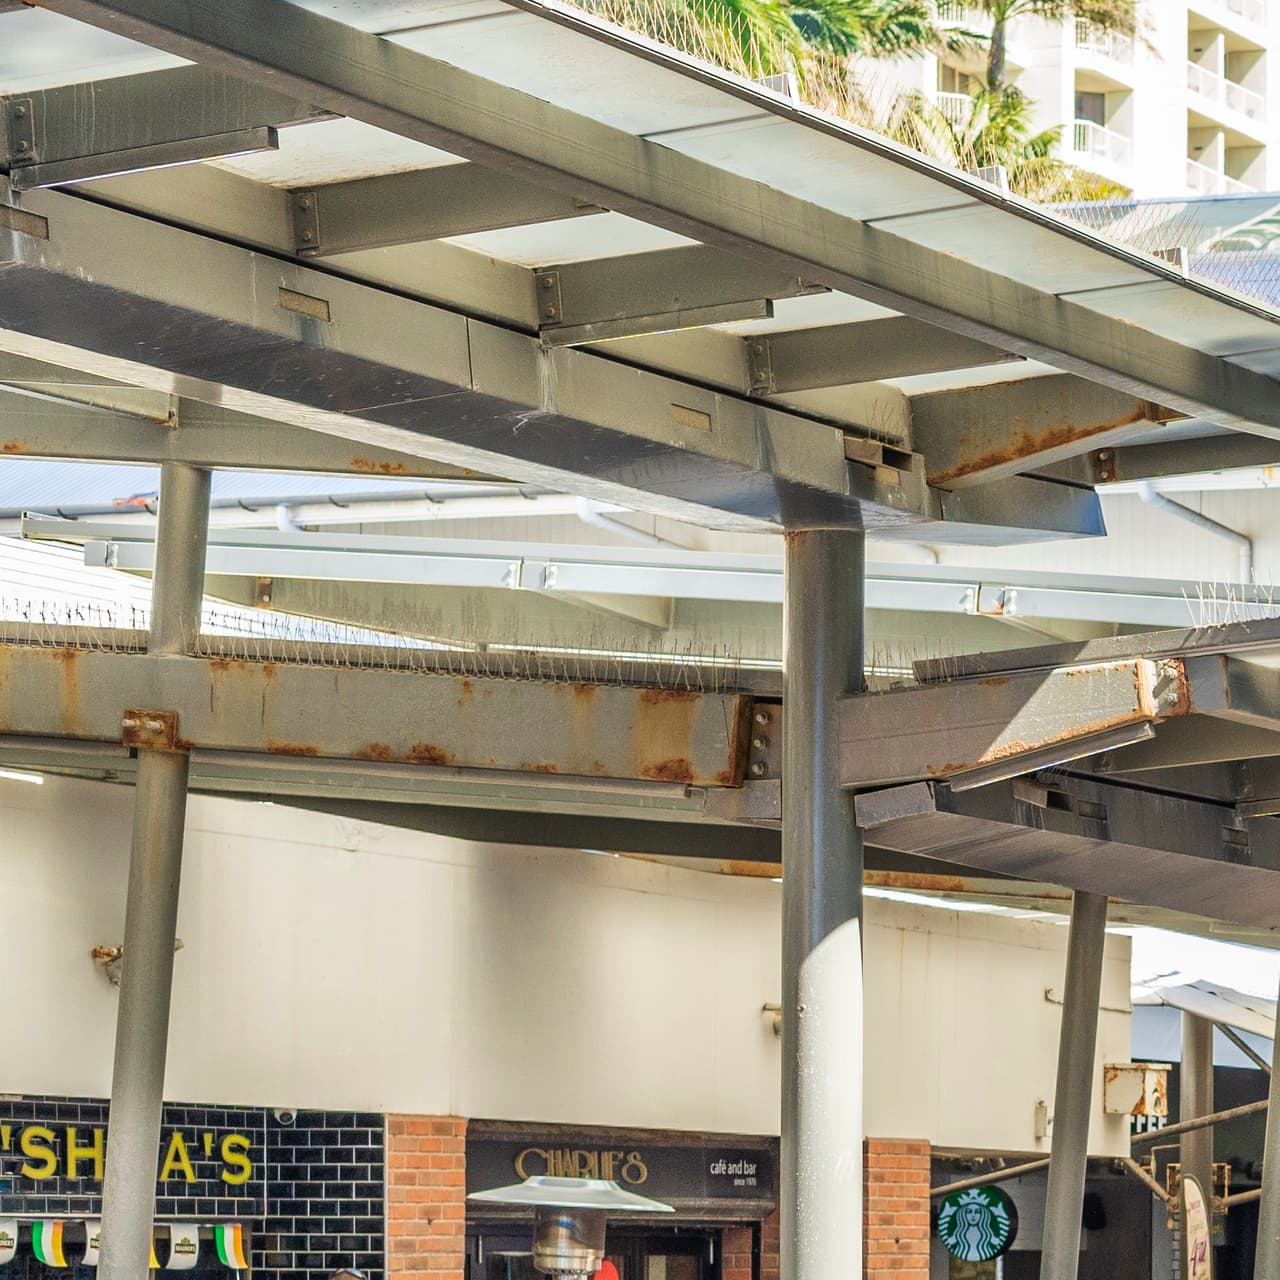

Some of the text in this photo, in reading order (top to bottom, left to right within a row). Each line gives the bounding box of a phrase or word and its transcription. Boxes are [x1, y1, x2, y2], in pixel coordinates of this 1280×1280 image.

[0, 1125, 252, 1185] 'SHA'S
[710, 1159, 757, 1175] café and bar
